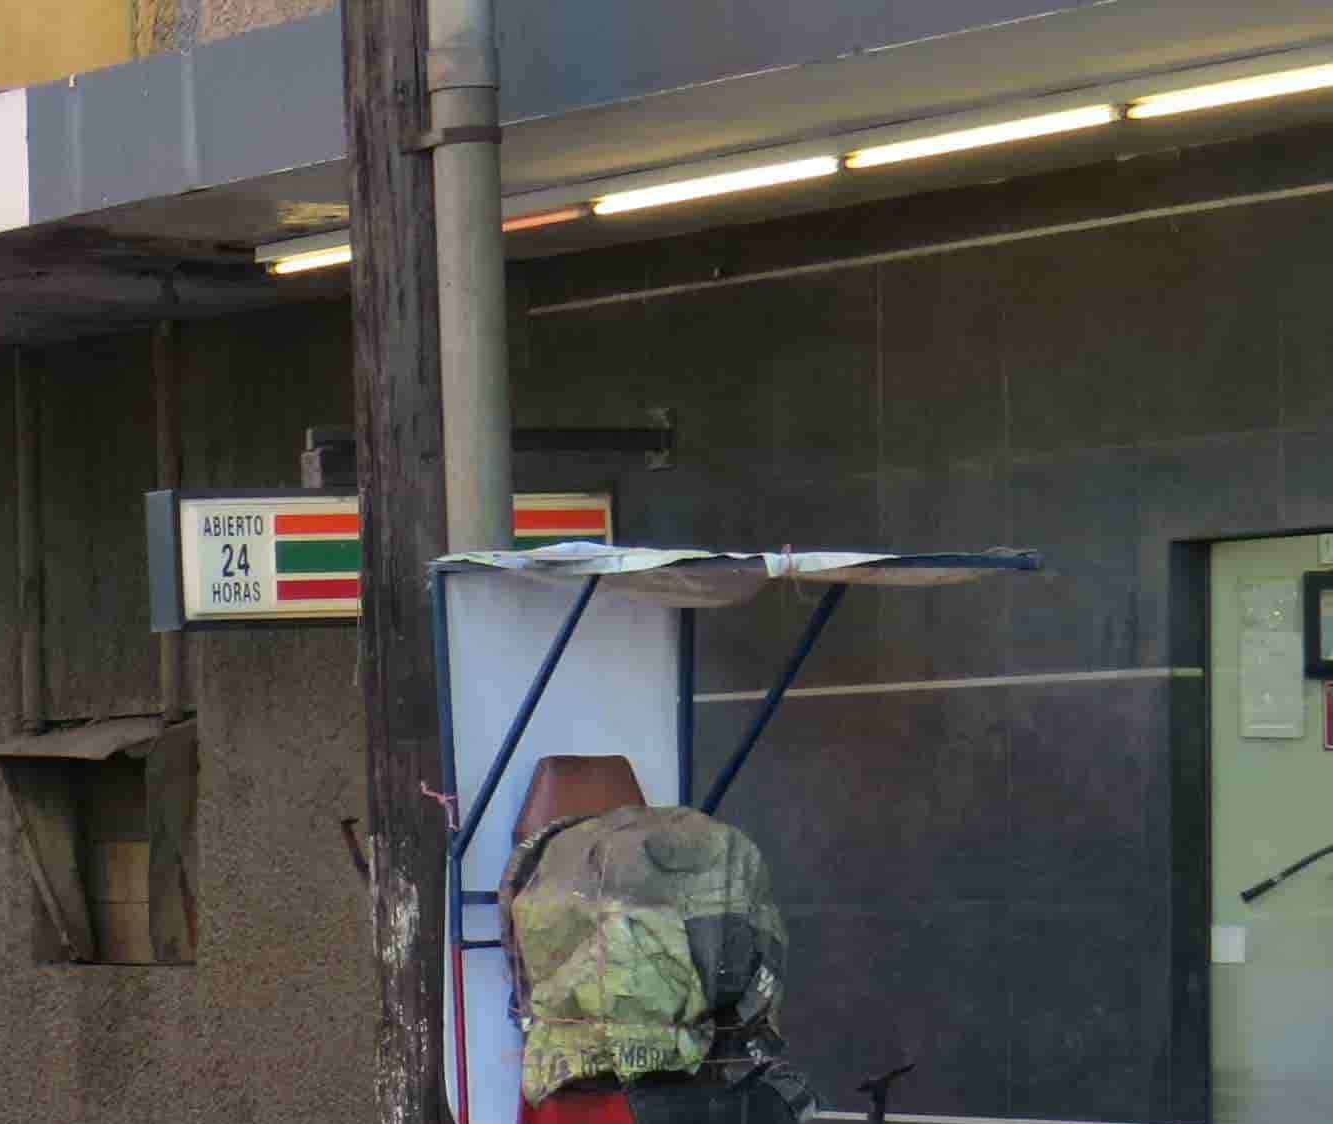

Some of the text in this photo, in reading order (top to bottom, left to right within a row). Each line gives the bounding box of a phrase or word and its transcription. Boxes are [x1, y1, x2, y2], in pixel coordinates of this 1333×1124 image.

[204, 515, 264, 536] ABIERTO
[220, 543, 251, 578] 24
[212, 582, 262, 603] HORAS
